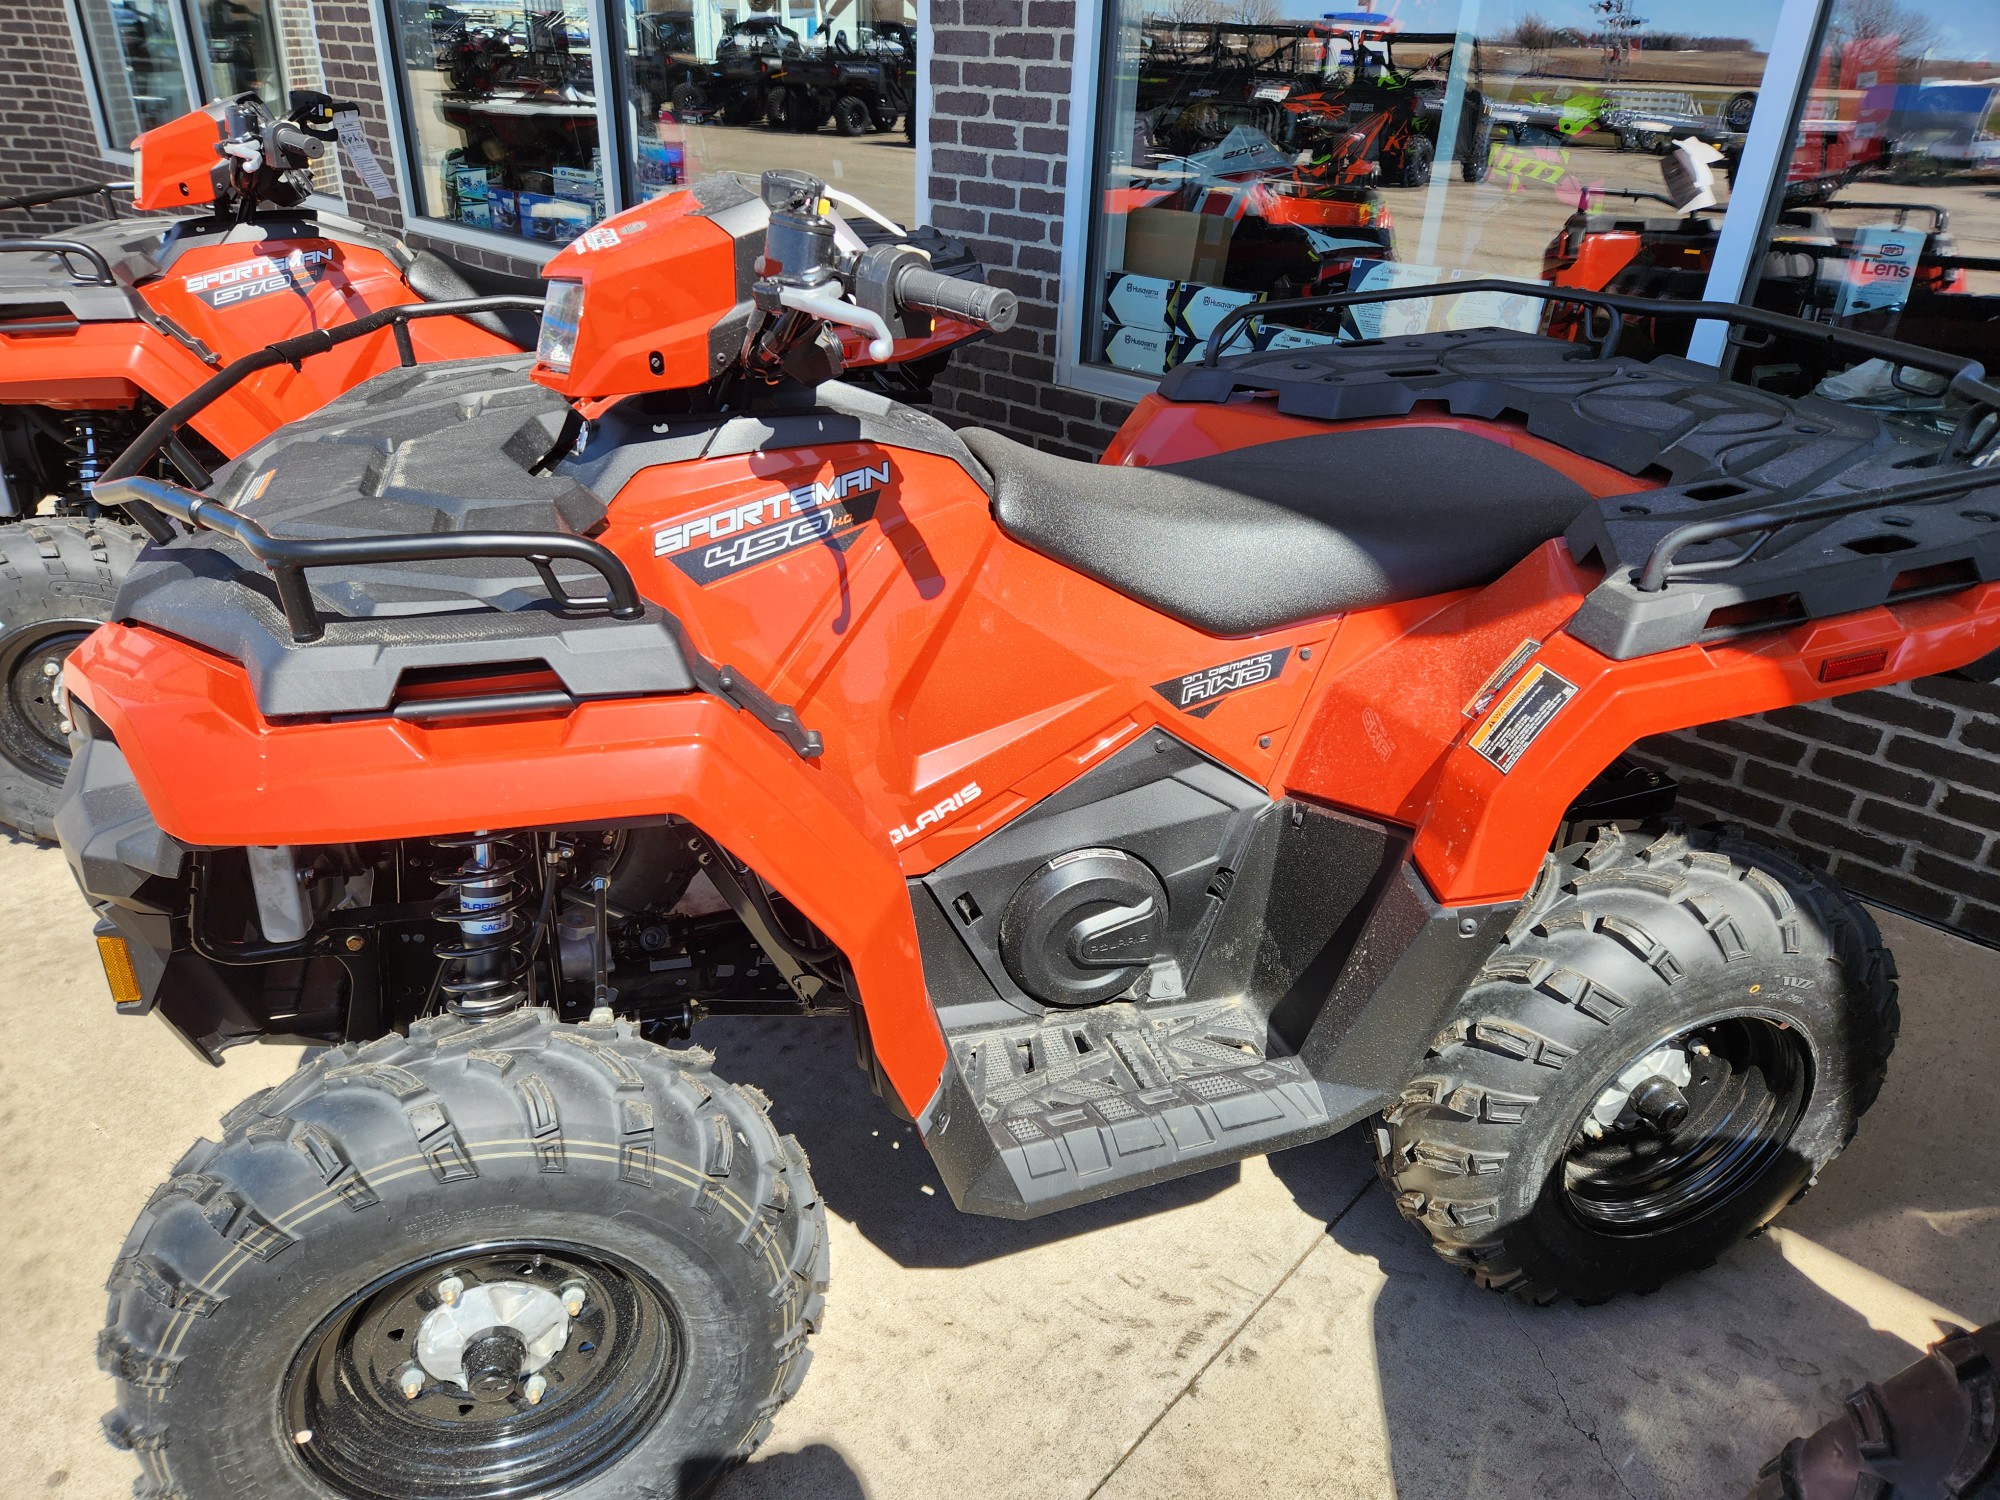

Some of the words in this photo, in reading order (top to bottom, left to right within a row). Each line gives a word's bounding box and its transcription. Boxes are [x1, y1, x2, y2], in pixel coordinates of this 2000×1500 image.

[186, 248, 334, 293] SPORTSMAN
[1861, 259, 1911, 278] Lens
[213, 273, 292, 306] 570
[1132, 285, 1159, 297] Husqvarna
[1130, 337, 1158, 349] Husqvarna
[654, 460, 891, 558] SPORTSMAN
[703, 509, 833, 569] 450
[1181, 662, 1272, 705] AWD
[1182, 672, 1203, 685] ON
[1208, 653, 1273, 677] DEMAND
[1493, 684, 1526, 722] WARNING
[888, 781, 982, 847] OLARIS
